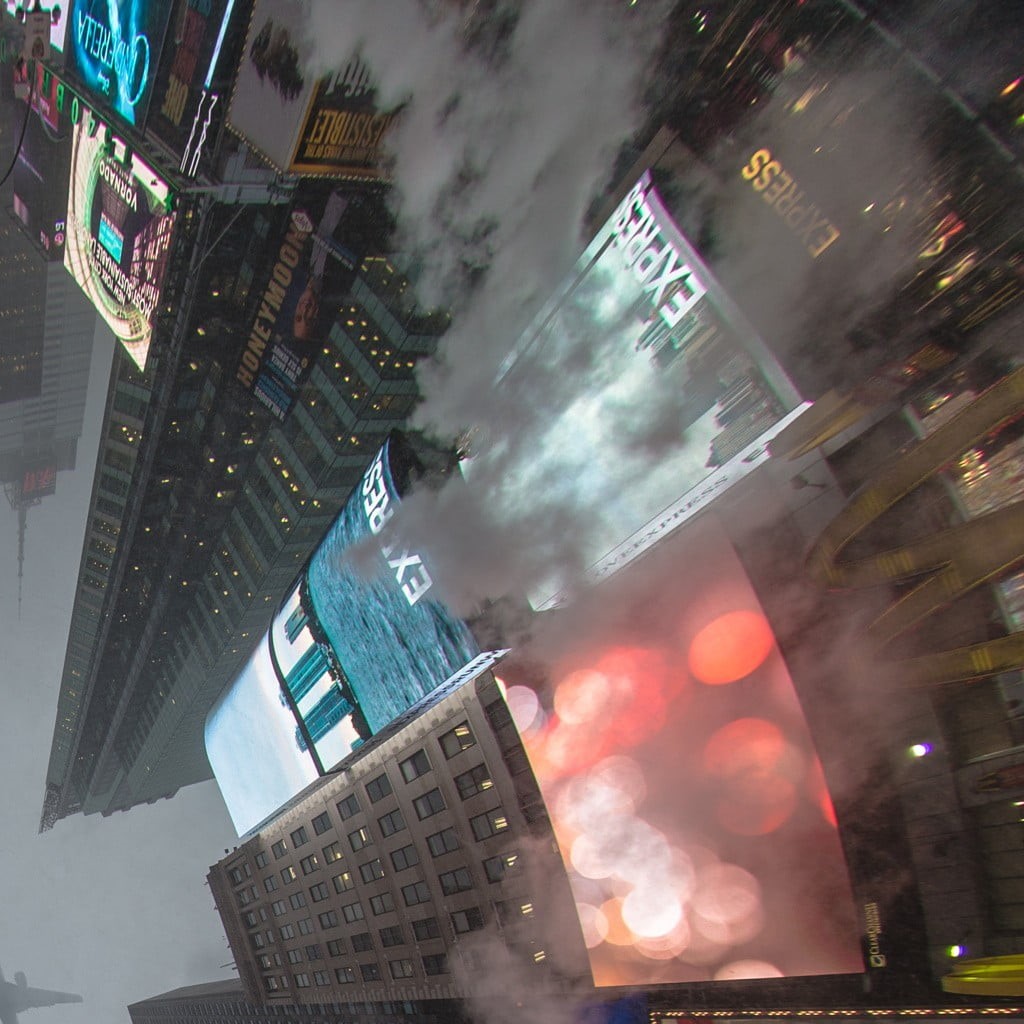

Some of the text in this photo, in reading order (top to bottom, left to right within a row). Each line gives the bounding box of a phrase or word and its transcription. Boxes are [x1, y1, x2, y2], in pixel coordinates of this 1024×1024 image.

[98, 159, 138, 212] VORNADO
[739, 145, 843, 258] EXPRESS
[94, 241, 134, 296] SUSTAINABLE
[99, 266, 116, 292] YORK
[616, 184, 708, 329] EXPRESS
[234, 224, 308, 388] HONEYMOON
